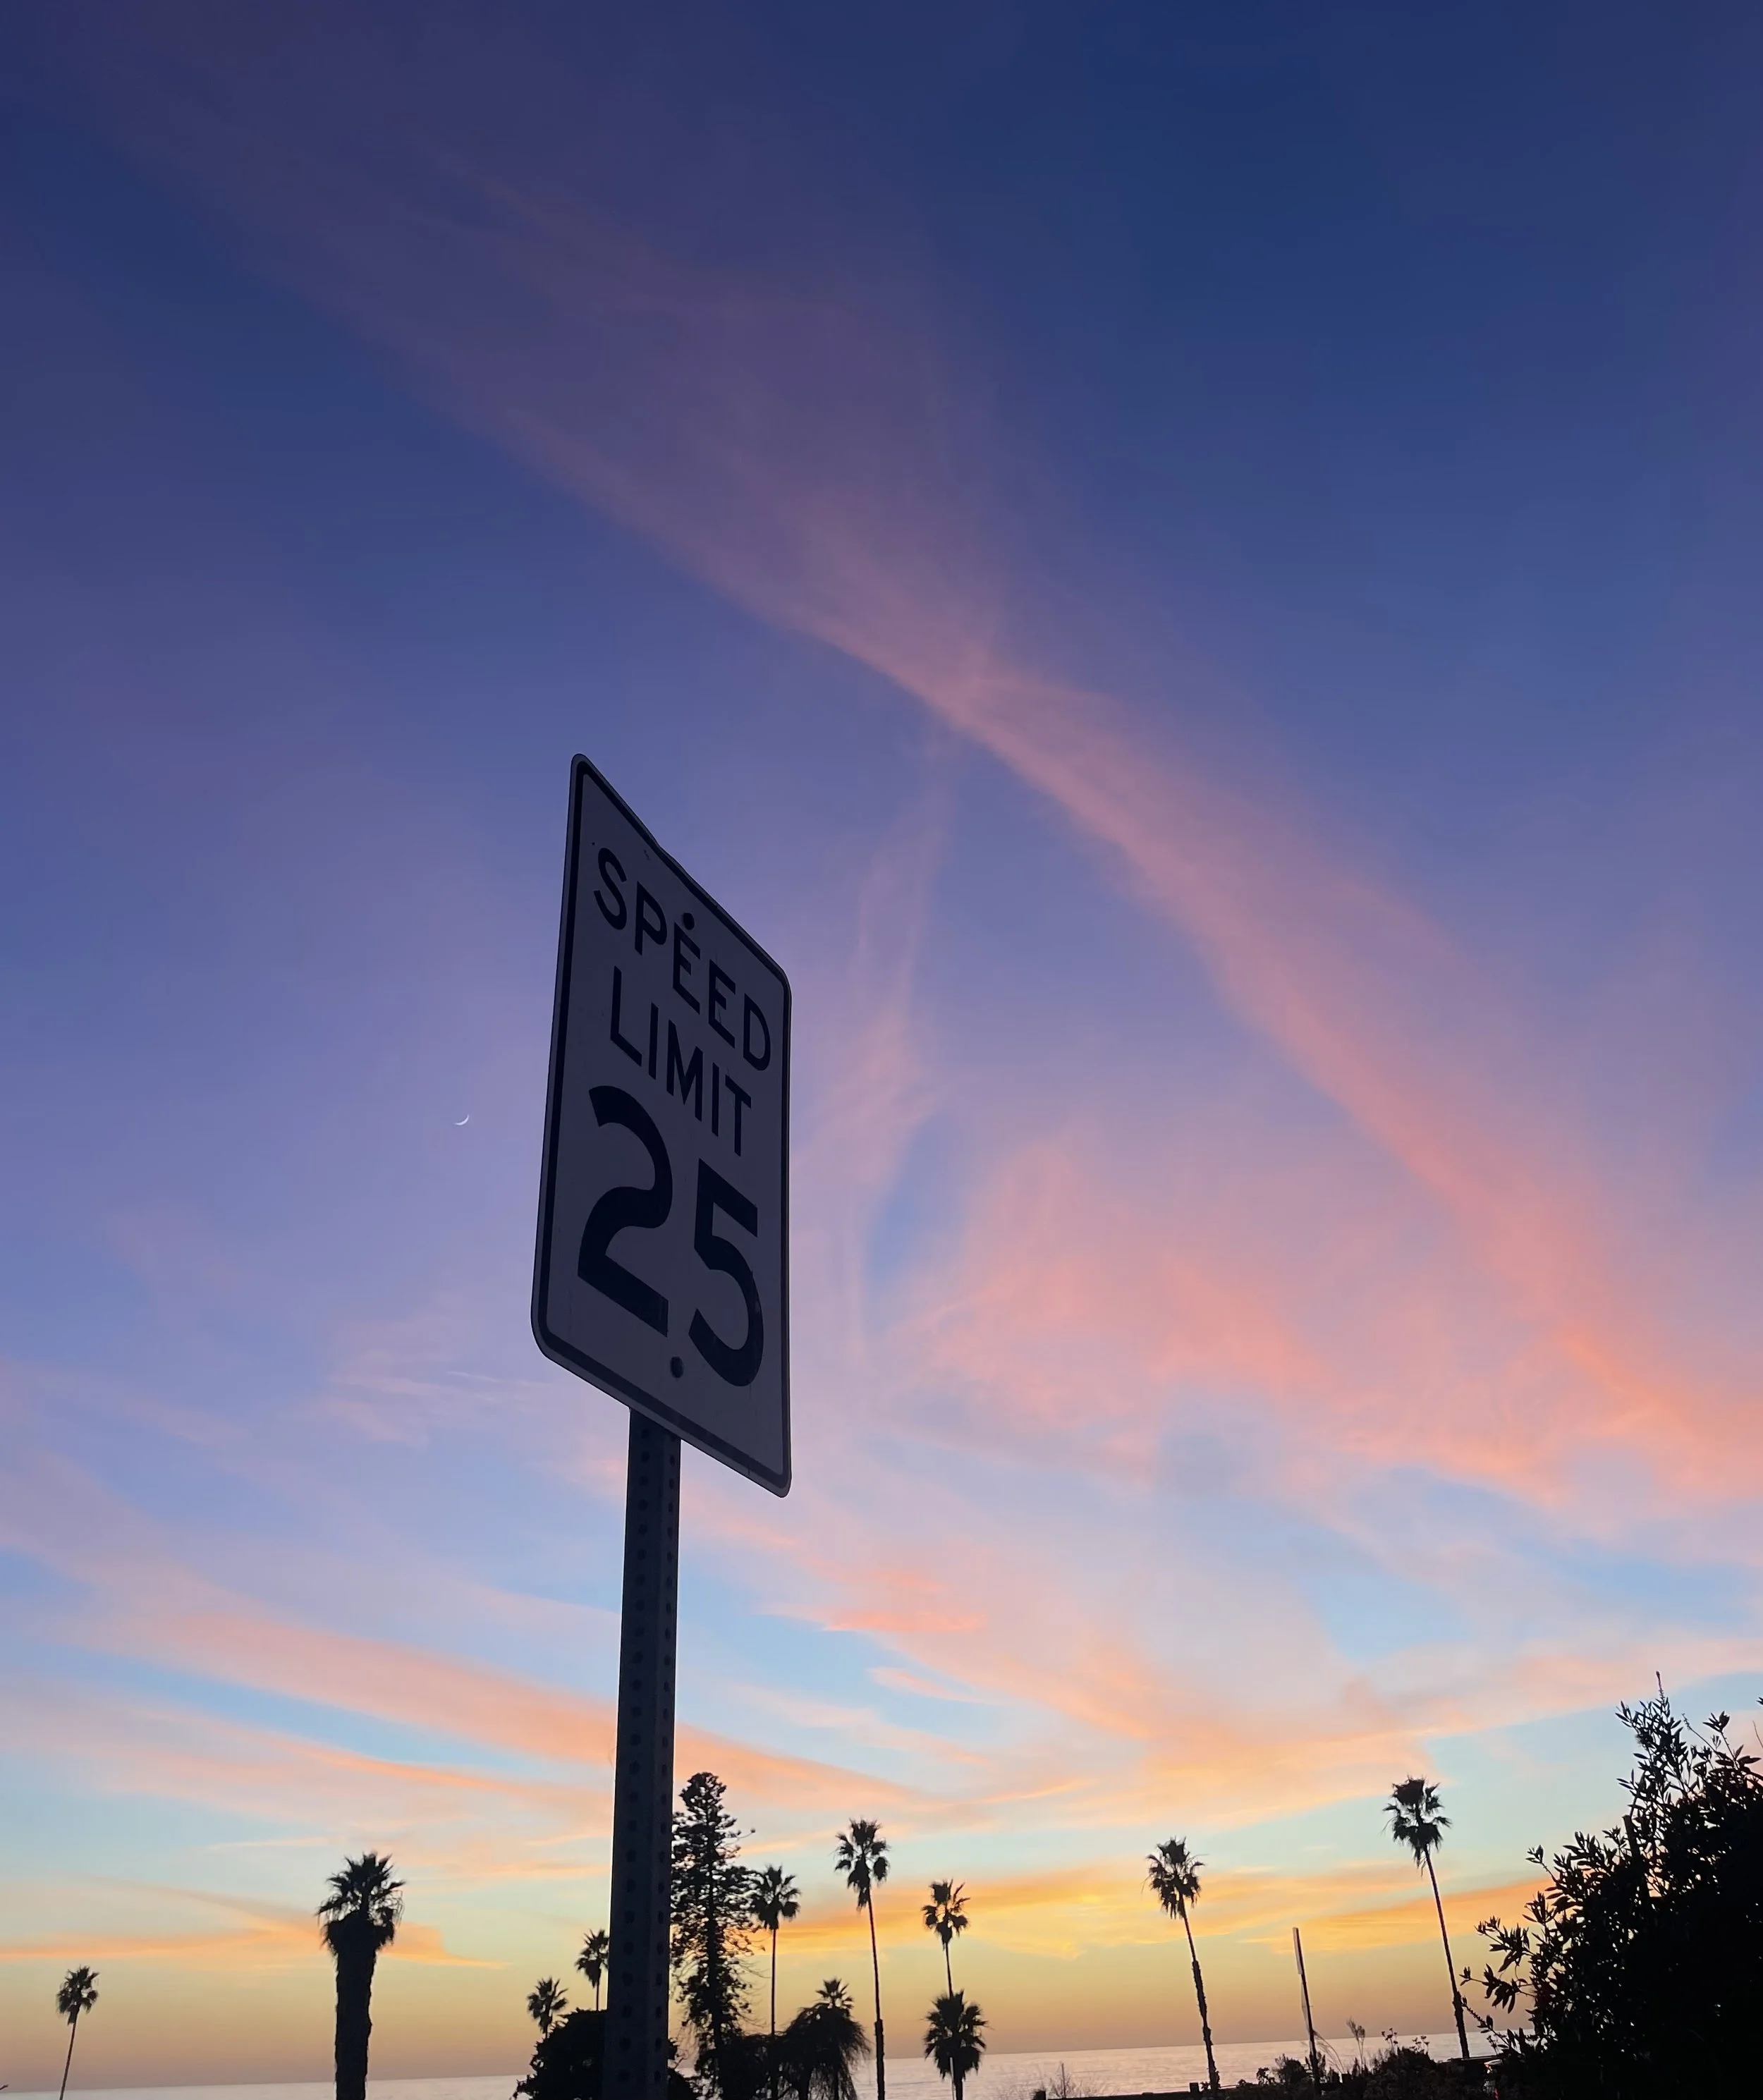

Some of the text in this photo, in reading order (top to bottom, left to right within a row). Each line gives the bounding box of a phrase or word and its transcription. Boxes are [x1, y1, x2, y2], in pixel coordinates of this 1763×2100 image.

[594, 848, 771, 1071] SPEED
[610, 965, 752, 1157] LIMIT
[577, 1085, 764, 1387] 25
